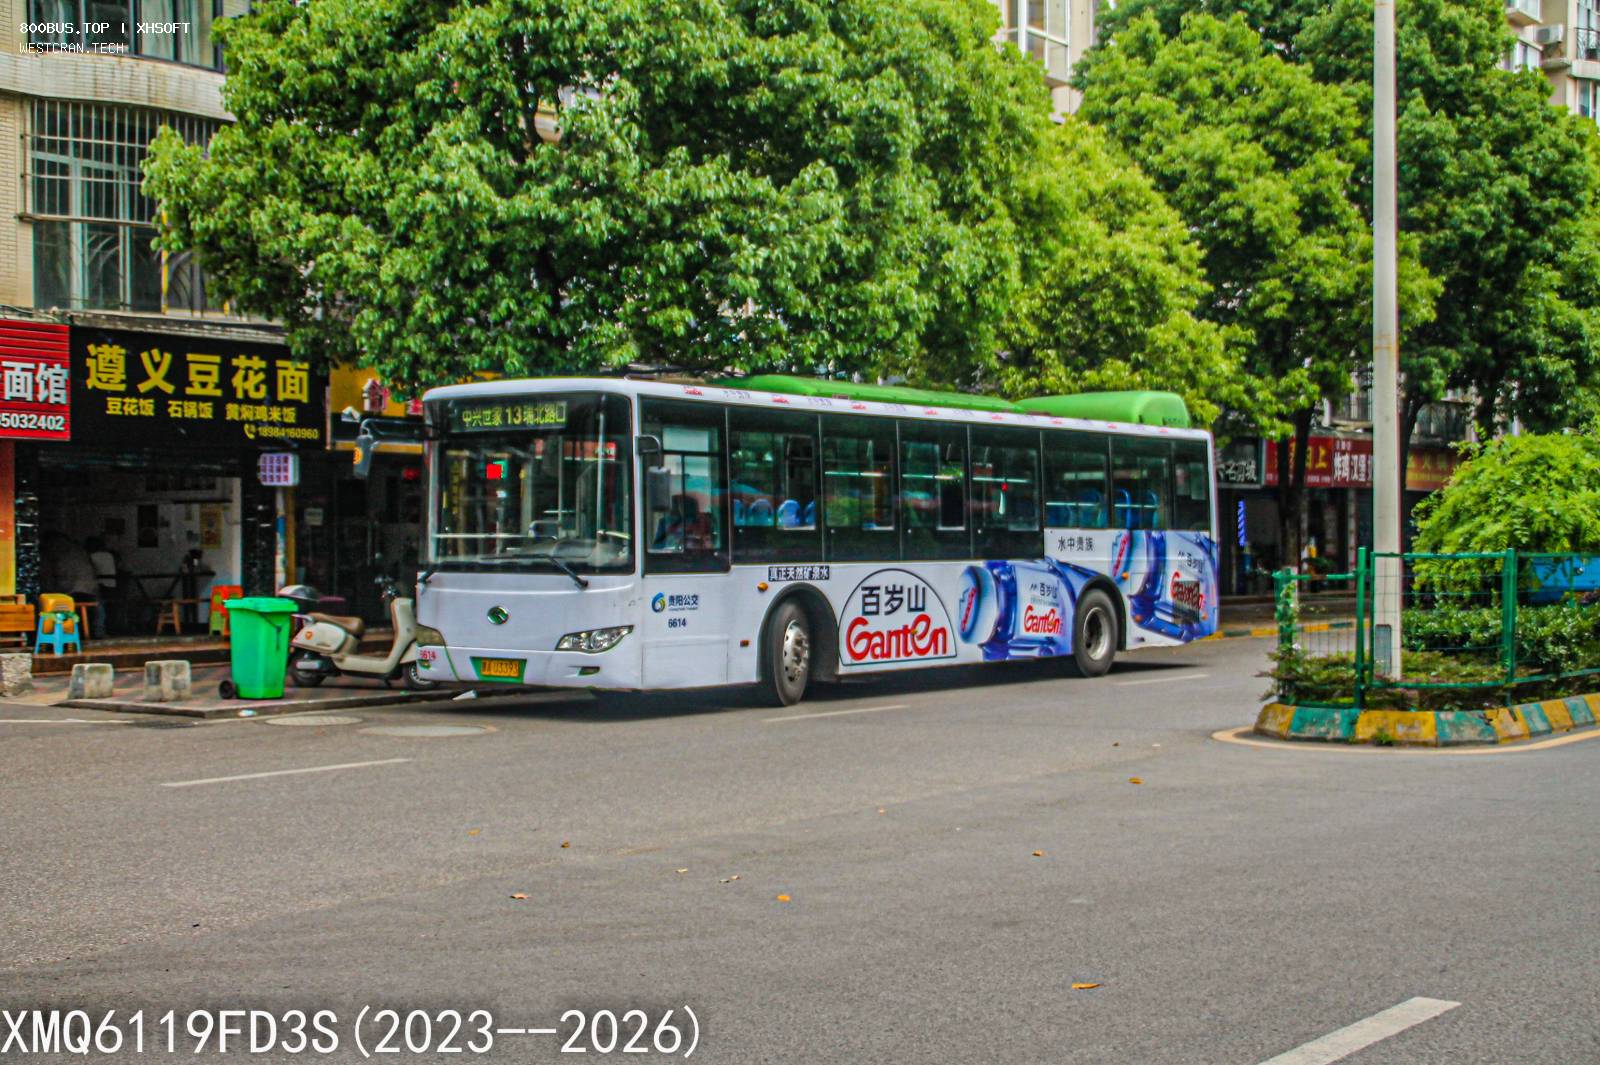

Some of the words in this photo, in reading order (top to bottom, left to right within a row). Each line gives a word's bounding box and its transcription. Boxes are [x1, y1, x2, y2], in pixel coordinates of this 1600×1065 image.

[0, 360, 69, 405] 面馆
[85, 343, 310, 403] 遵义豆花面
[106, 397, 155, 417] 豆花饭
[167, 400, 214, 420] 石锅饭
[225, 403, 296, 424] 黄焖鸡米饭
[505, 405, 523, 425] 13
[257, 425, 319, 440] 18984160960
[1057, 536, 1094, 551] 水中贵族
[668, 593, 699, 607] 贵阳公交
[862, 585, 926, 616] 百岁山
[668, 618, 687, 628] 6614
[846, 614, 948, 661] Ganten
